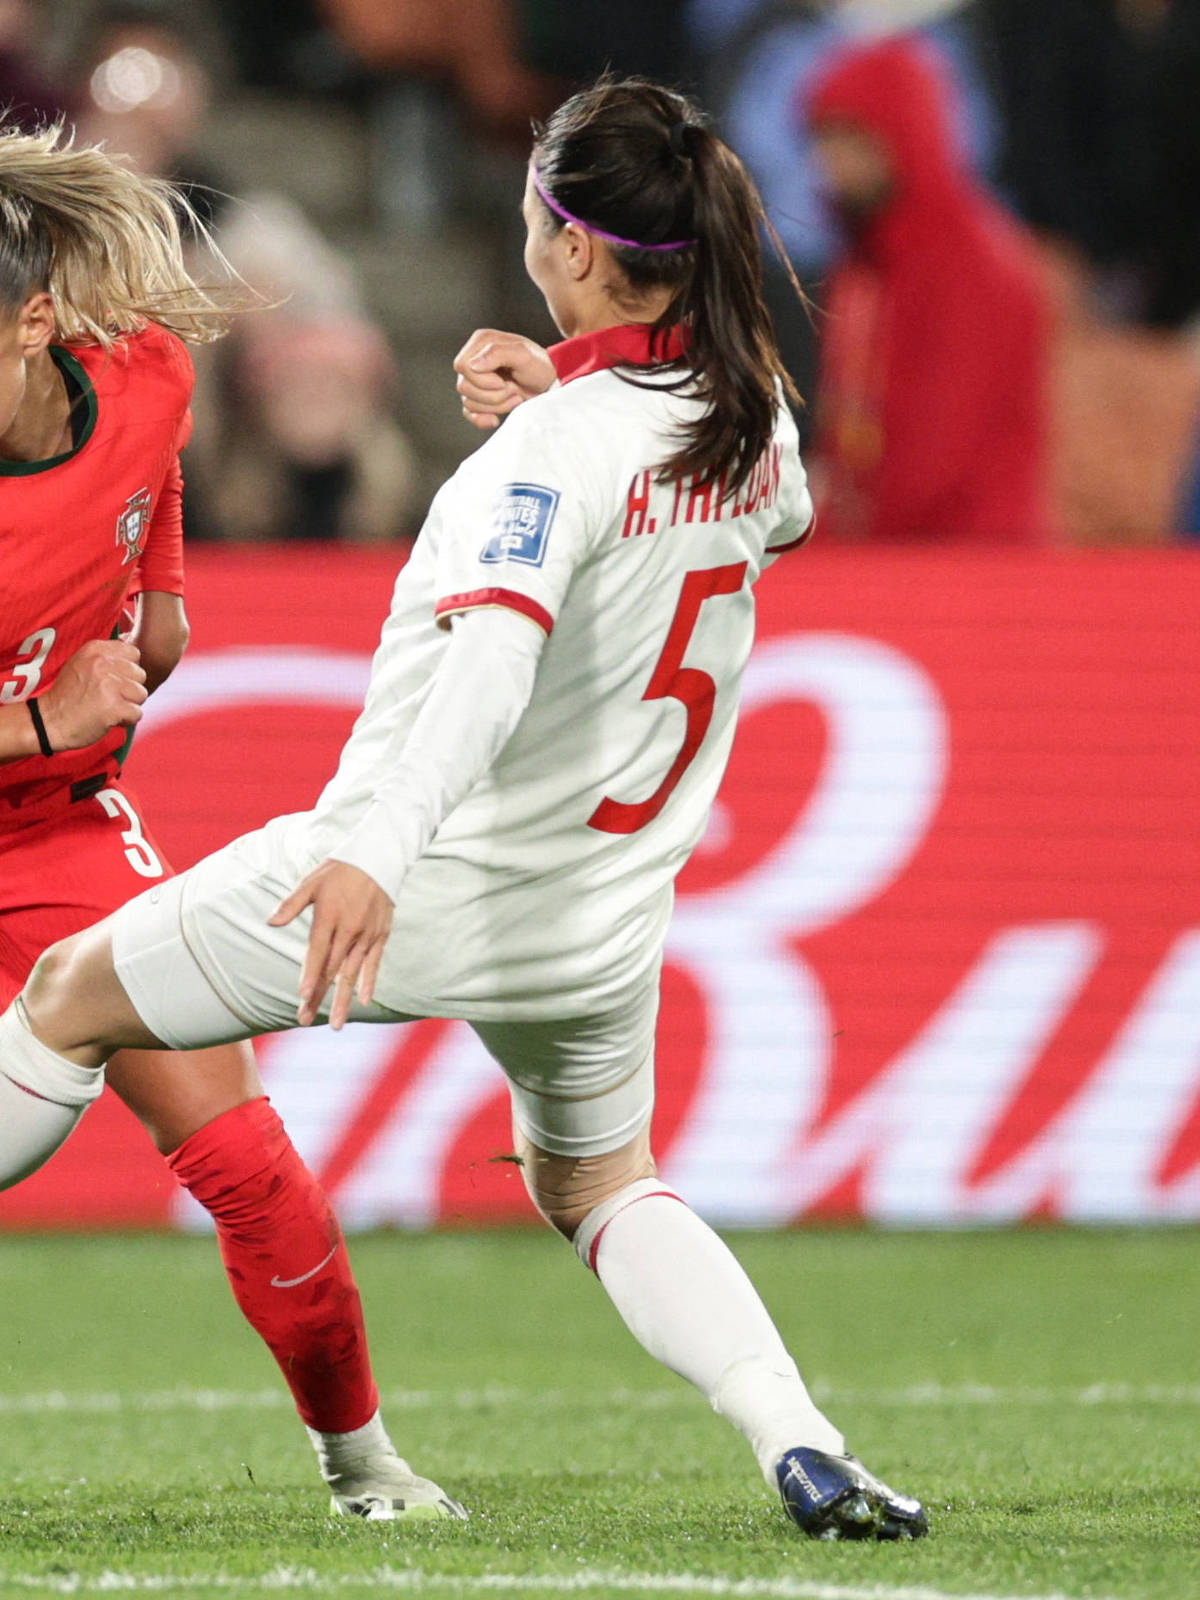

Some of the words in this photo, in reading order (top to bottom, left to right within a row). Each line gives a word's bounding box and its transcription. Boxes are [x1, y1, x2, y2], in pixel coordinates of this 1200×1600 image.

[621, 470, 657, 538] H.
[0, 627, 57, 704] 3
[587, 560, 749, 834] 5
[94, 788, 164, 878] 3
